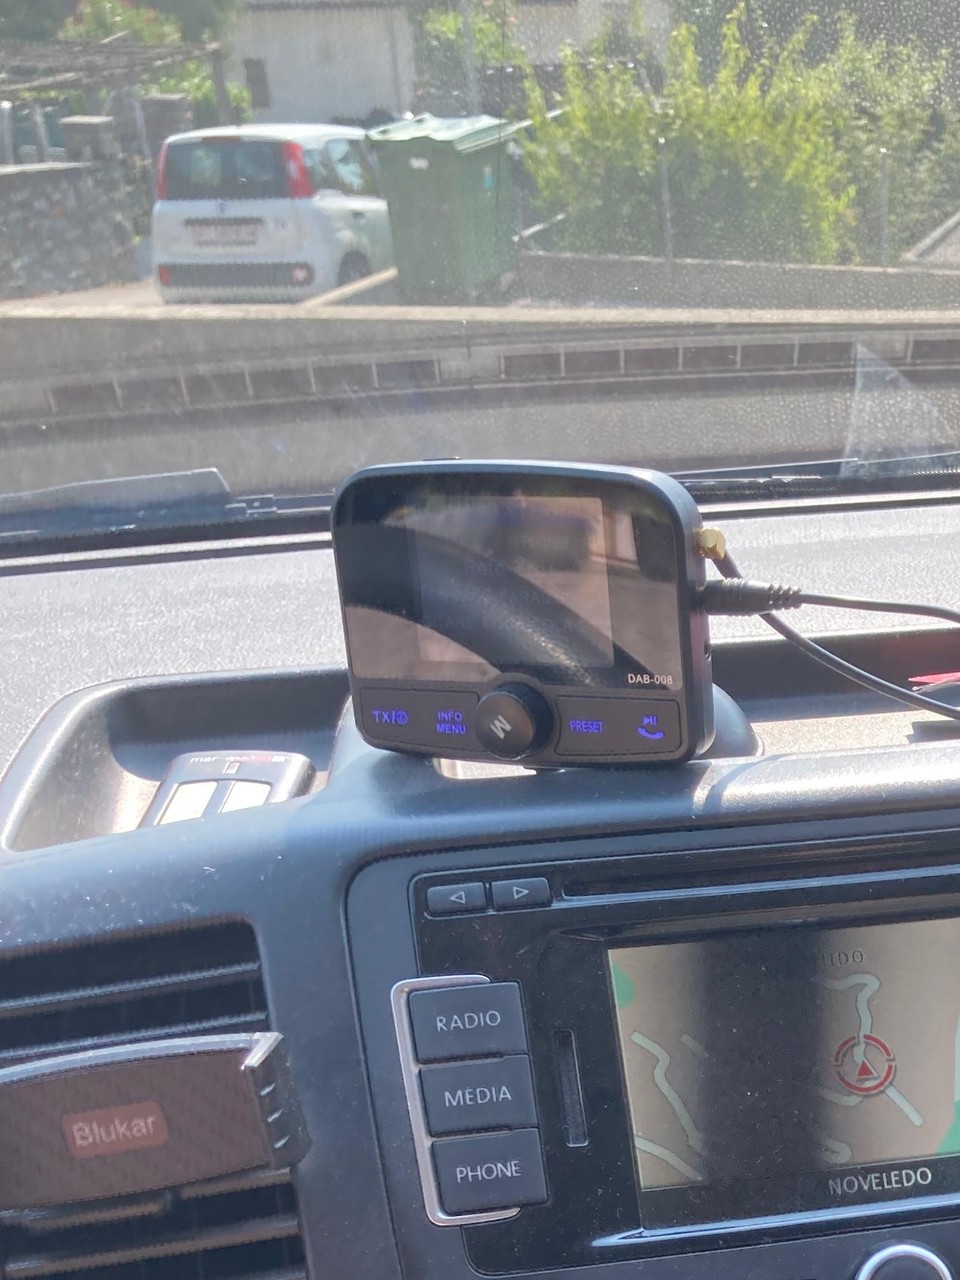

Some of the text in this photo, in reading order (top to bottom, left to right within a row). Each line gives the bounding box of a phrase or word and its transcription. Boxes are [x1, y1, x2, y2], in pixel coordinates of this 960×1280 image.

[627, 672, 674, 686] DAB-008
[437, 710, 462, 722] INFO
[569, 719, 605, 733] PRESET
[436, 723, 467, 735] MENU
[436, 1010, 501, 1032] RADIO
[444, 1085, 512, 1107] MEDIA
[72, 1115, 156, 1148] Blukar
[456, 1160, 522, 1183] PHONE
[828, 1167, 933, 1195] NOVELEDO
